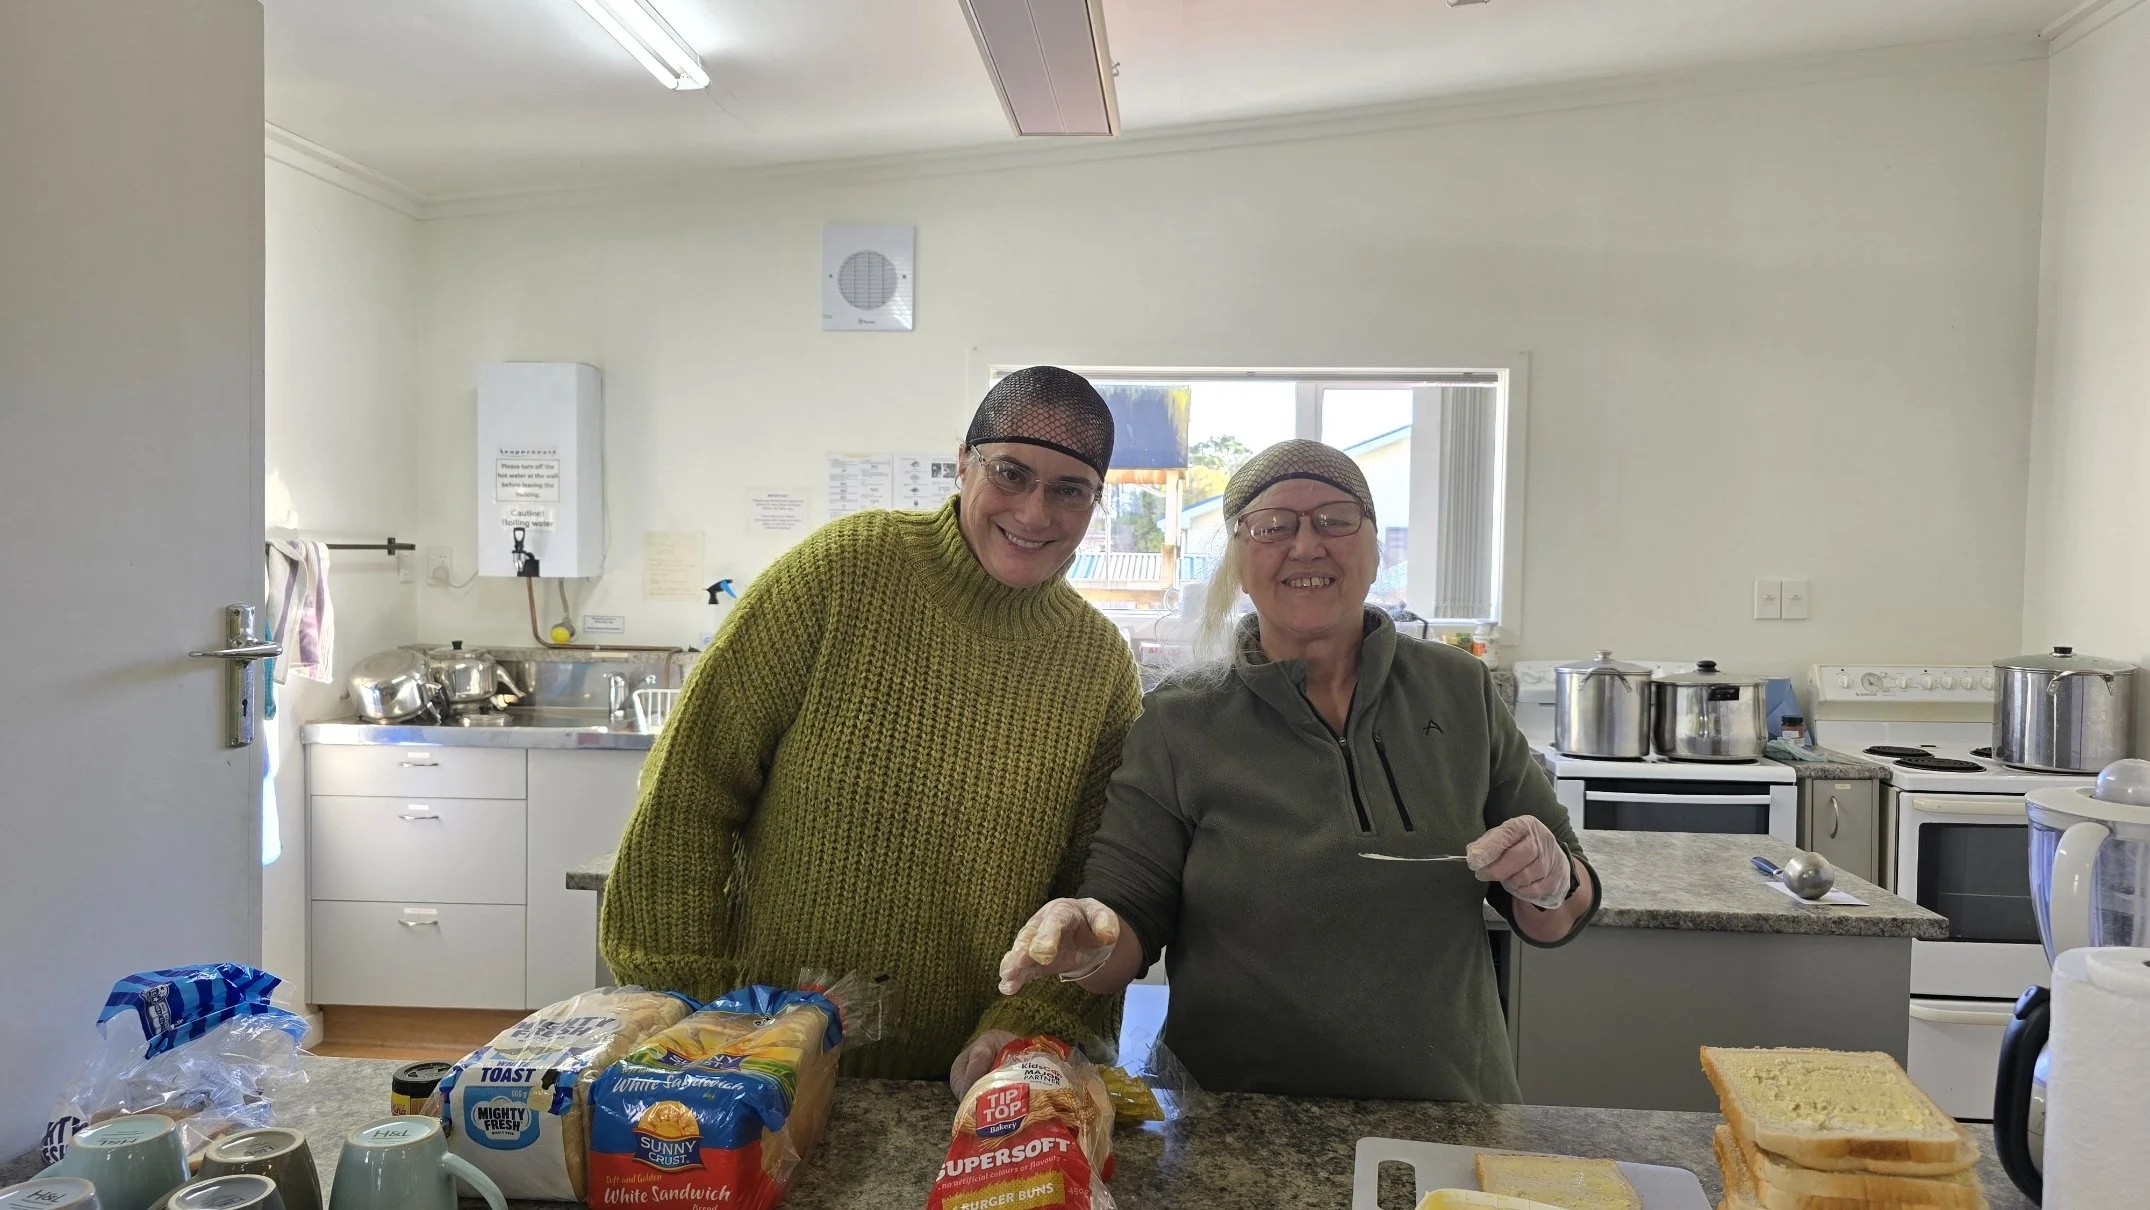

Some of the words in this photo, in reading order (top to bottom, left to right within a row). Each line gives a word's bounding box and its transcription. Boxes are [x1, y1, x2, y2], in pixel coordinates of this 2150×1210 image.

[522, 482, 543, 490] leaving
[480, 1067, 536, 1083] TOAST
[1023, 1074, 1061, 1086] PARTNER
[1024, 1069, 1061, 1082] MAJOR
[612, 1076, 660, 1093] White
[988, 1089, 1019, 1108] TIP
[478, 1107, 525, 1120] MIGHTY
[983, 1101, 1022, 1122] TOP
[484, 1119, 521, 1131] FRESH
[989, 1122, 1017, 1134] Bakery
[640, 1136, 697, 1155] SUNNY
[648, 1152, 687, 1166] CRUST
[606, 1175, 620, 1185] Soft
[621, 1174, 636, 1184] and
[637, 1173, 663, 1183] Golden
[941, 1182, 952, 1190] no
[953, 1172, 988, 1186] artificial
[990, 1165, 1018, 1178] colours
[1020, 1164, 1029, 1172] or
[1029, 1155, 1061, 1171] flavours
[604, 1187, 649, 1204] White
[651, 1182, 732, 1202] Sandwich
[1018, 1182, 1054, 1201] BUNS
